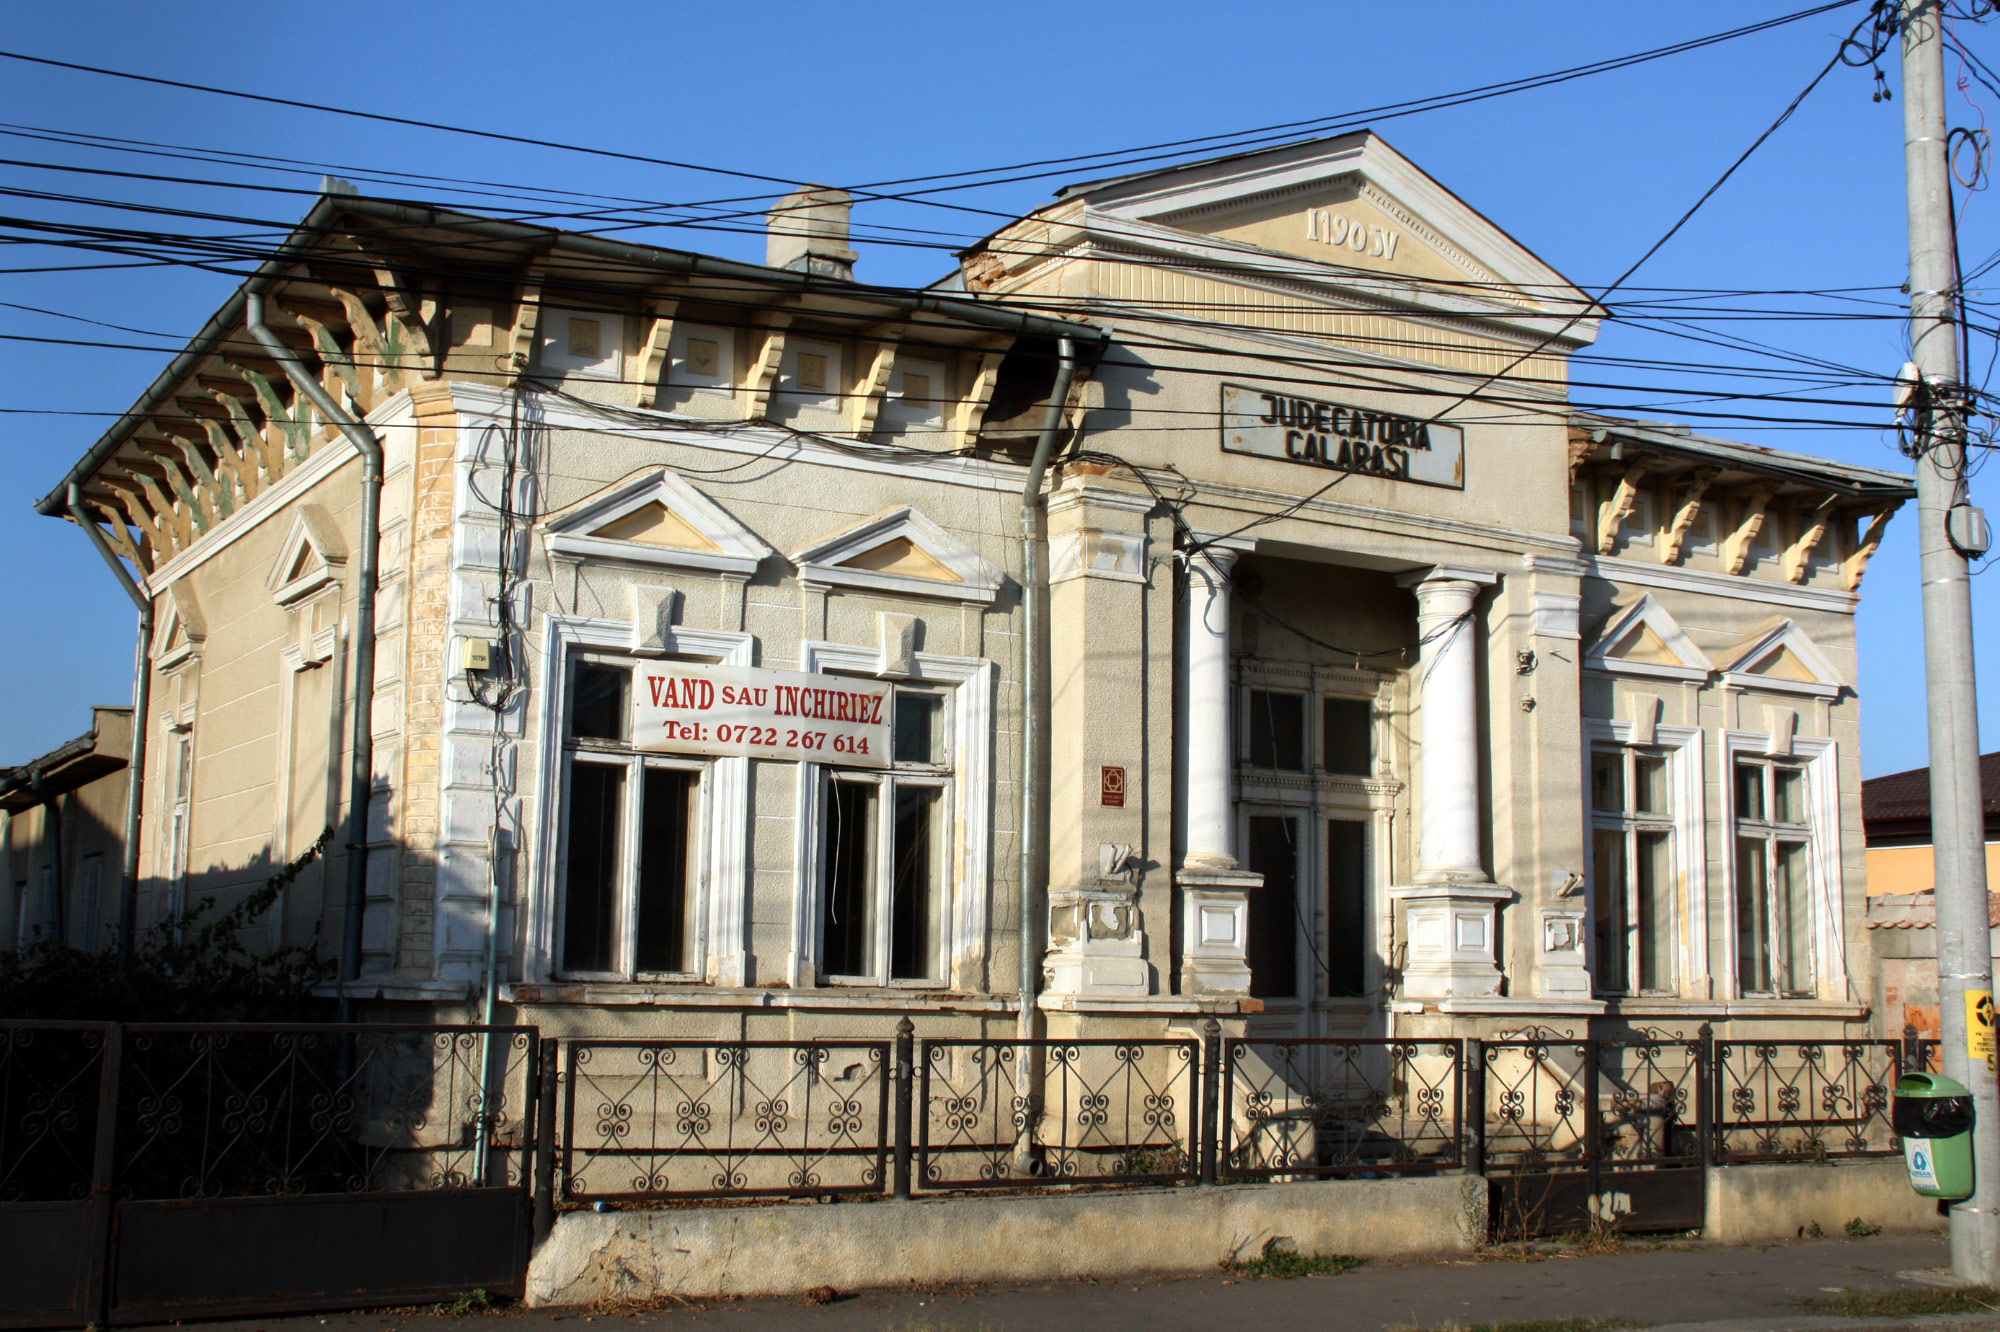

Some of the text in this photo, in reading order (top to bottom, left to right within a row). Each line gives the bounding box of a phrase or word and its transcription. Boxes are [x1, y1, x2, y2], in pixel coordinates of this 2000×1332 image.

[1261, 394, 1432, 451] JUDECATORIA
[648, 676, 883, 725] VAND SAU INCHIRIEZ
[663, 720, 869, 754] Tel: 0722 267 614
